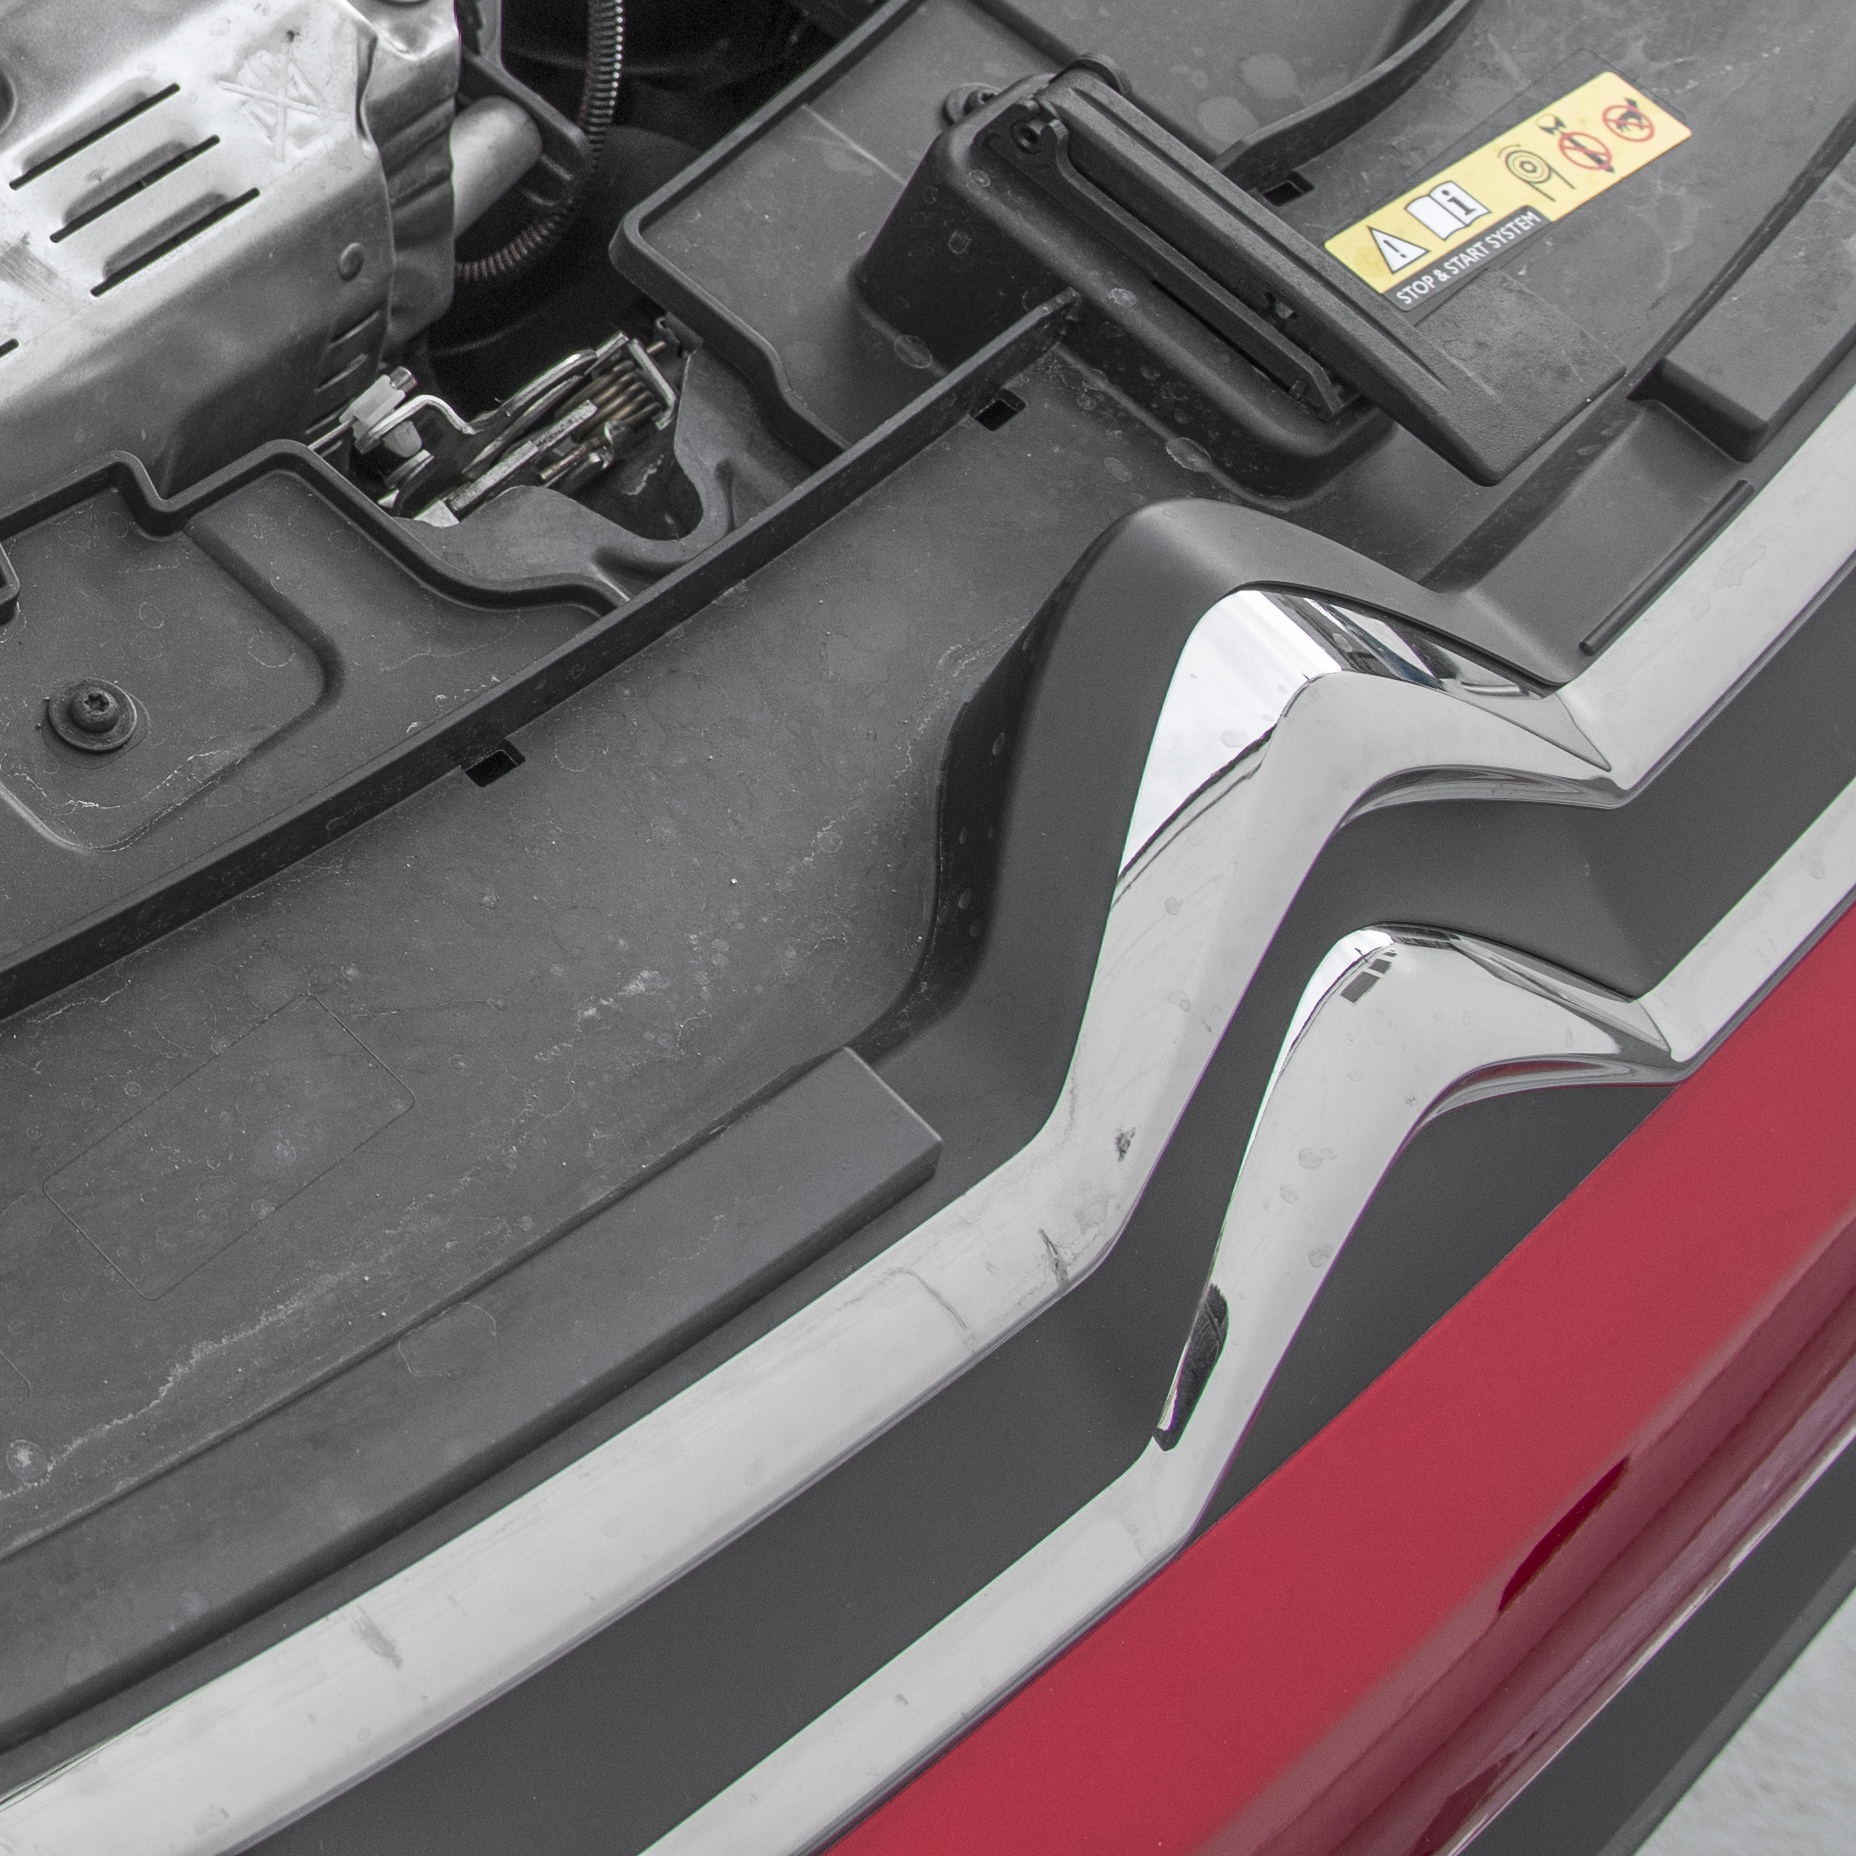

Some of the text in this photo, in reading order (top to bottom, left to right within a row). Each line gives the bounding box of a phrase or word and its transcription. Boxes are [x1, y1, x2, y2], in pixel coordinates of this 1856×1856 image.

[1395, 210, 1543, 306] STOP & START SYSTEM
